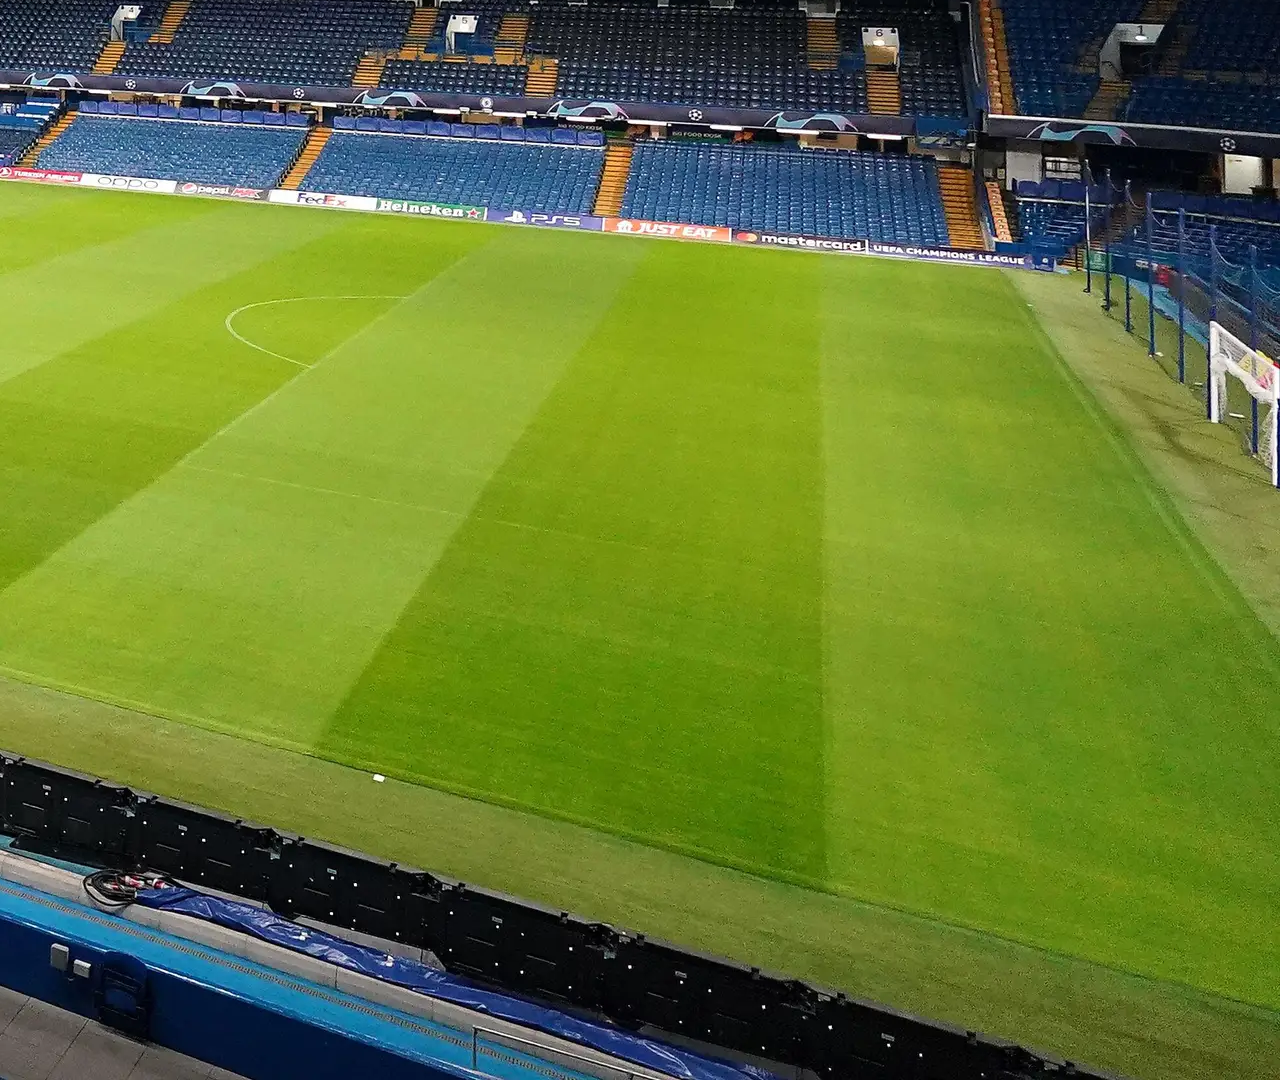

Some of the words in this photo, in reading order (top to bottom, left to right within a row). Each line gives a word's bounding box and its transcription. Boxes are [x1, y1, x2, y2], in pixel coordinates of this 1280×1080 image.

[875, 28, 884, 37] 6
[14, 170, 46, 178] TURKISH
[46, 173, 80, 182] AIRLINES
[97, 176, 159, 190] oppo
[197, 186, 230, 196] pepsi
[297, 193, 347, 207] FedEx
[378, 200, 464, 217] Heineken
[531, 213, 581, 226] PS5
[638, 222, 680, 235] JUST
[681, 226, 717, 239] EAT
[761, 235, 862, 251] mastercard
[874, 245, 904, 254] UEFA
[905, 247, 975, 260] CHAMPIONS
[978, 254, 1025, 265] LEAGUE
